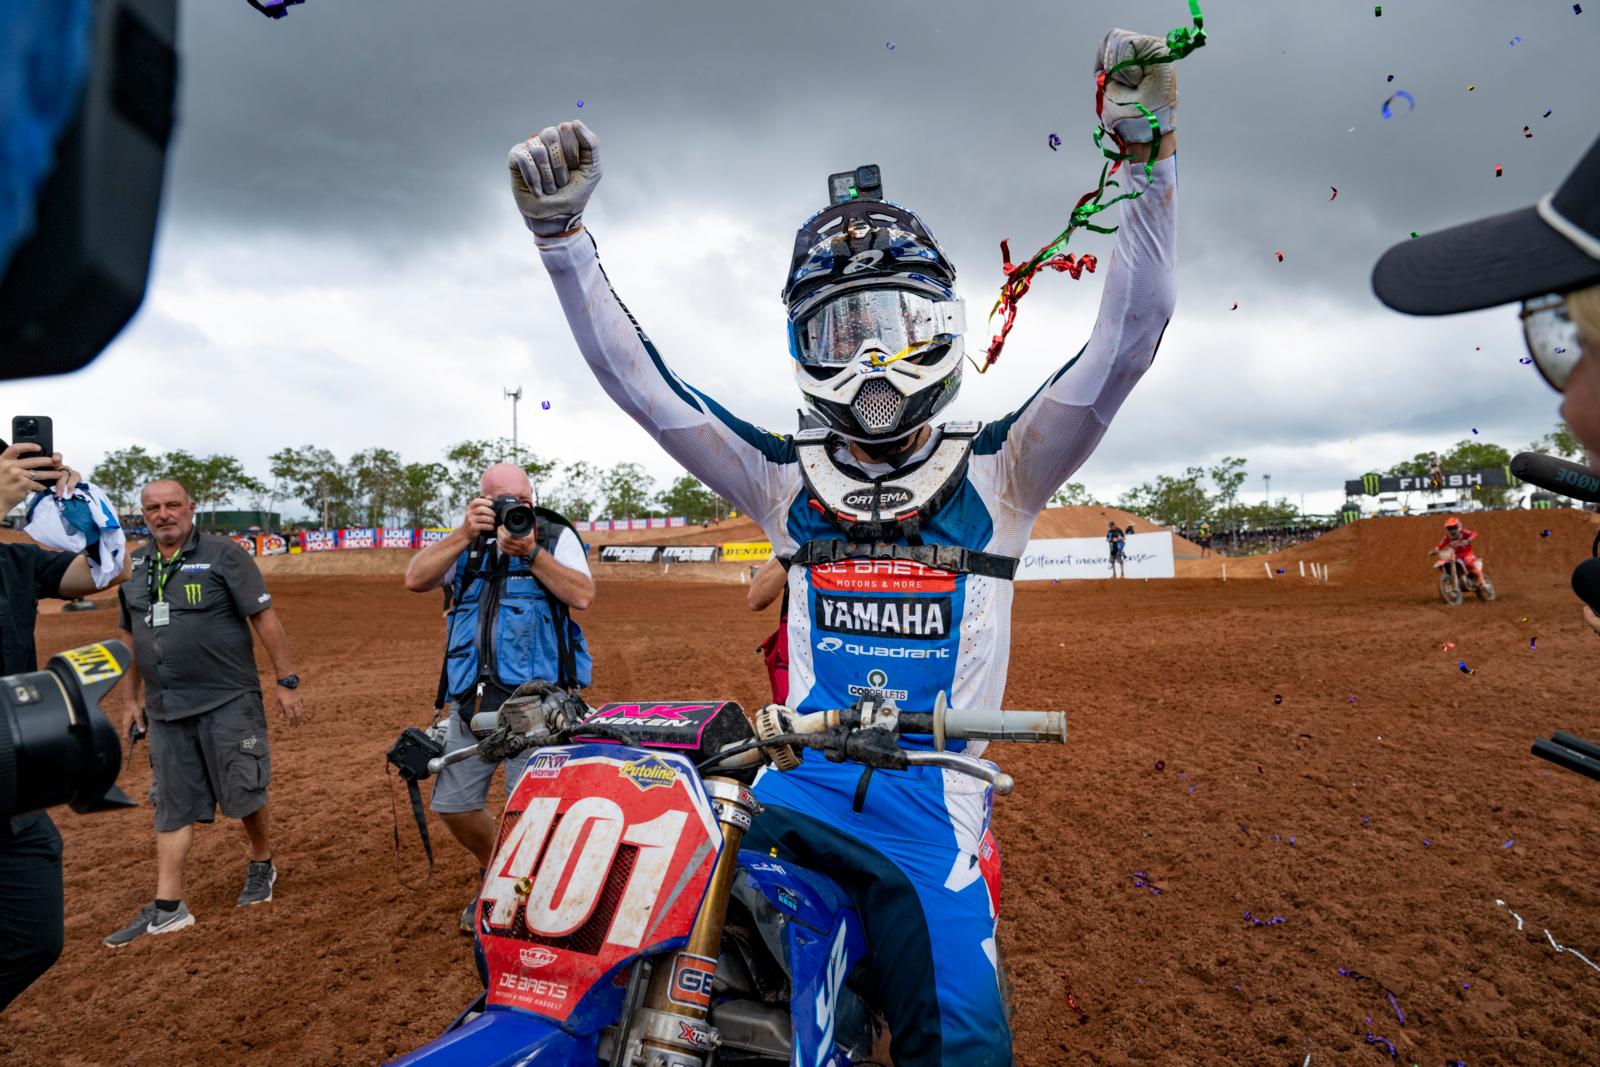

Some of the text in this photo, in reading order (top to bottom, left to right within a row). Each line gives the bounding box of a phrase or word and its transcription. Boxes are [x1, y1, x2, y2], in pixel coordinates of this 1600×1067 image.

[846, 491, 909, 504] ORTEMA
[307, 532, 333, 541] LIQUI
[345, 530, 371, 538] LIQUI
[384, 530, 410, 538] LIQUI
[306, 541, 334, 550] MOLY
[345, 538, 373, 547] MOLY
[383, 538, 411, 547] MOLY
[1025, 555, 1073, 568] Different
[837, 580, 922, 588] MOTORS & MORE
[822, 598, 945, 635] YAMAHA
[845, 643, 950, 659] quadrant
[590, 717, 692, 727] NEKEN
[622, 761, 676, 780] Putoline
[480, 797, 689, 948] 401
[500, 972, 518, 989] DE
